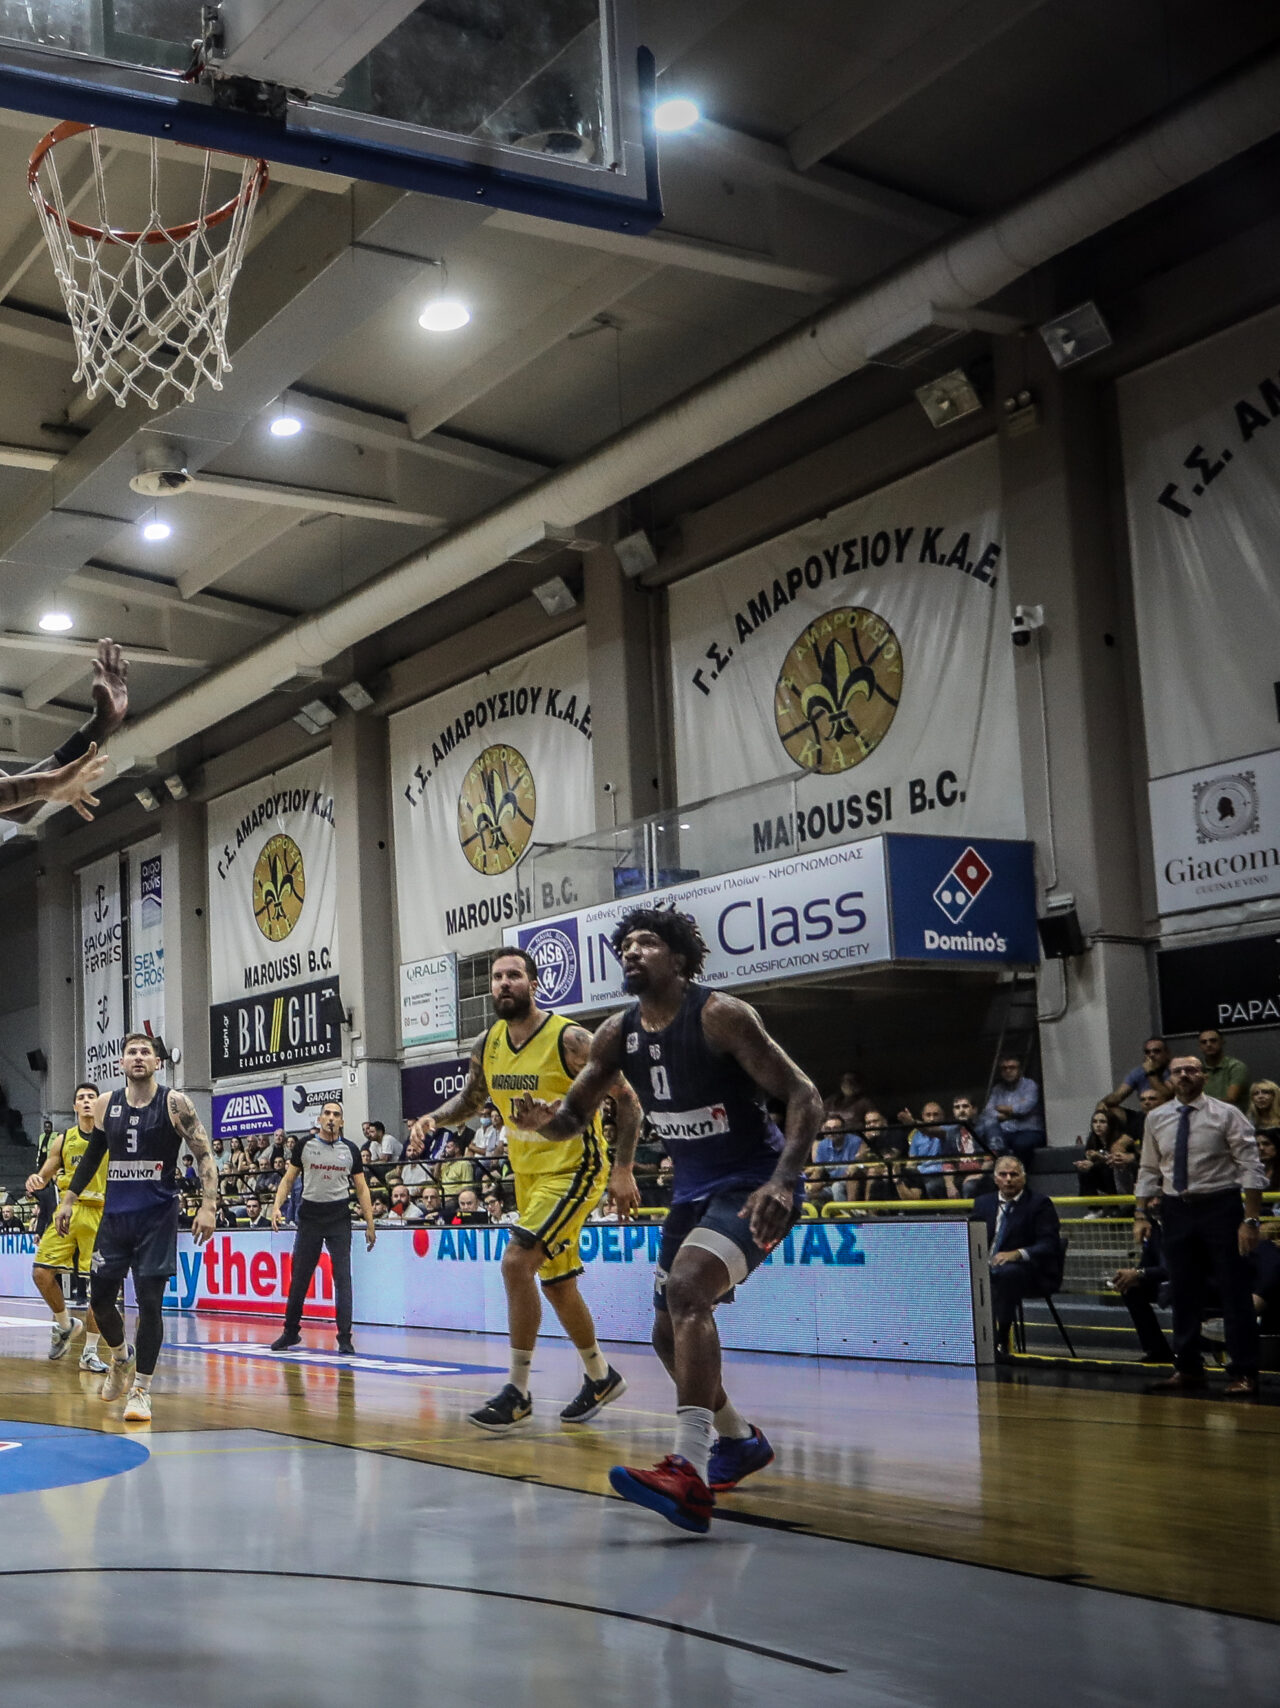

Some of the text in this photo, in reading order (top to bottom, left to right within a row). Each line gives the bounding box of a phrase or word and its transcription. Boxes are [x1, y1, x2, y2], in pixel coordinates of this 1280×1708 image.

[1158, 444, 1233, 518] Γ.Σ.
[692, 641, 734, 696] Γ.Σ.
[734, 527, 914, 645] ΑΜΑΡΟΥΣΙΟΥ
[918, 527, 1001, 589] Κ.Α.Ε.
[404, 764, 432, 808] Γ.Σ.
[431, 687, 542, 768] ΑΜΑΡΟΥΣΙΟΥ
[236, 789, 310, 848] ΑΜΑΡΟΥΣΙΟΥ
[753, 770, 966, 854] MAROUSSI B.C.
[586, 908, 616, 923] Διεθνές
[723, 873, 760, 891] Πλοίων
[768, 848, 864, 881] ΝΗΟΓΝΩΜΟΝΑΣ
[445, 876, 578, 937] MAROUSSI B.C.
[718, 891, 868, 956] Class
[924, 929, 1007, 954] Domino's
[135, 952, 155, 972] SEA
[244, 947, 332, 990] MAROUSSI B.C.
[737, 953, 819, 976] CLASSIFICATION
[823, 943, 870, 962] SOCIETY
[239, 1043, 331, 1068] ΕΙΔΙΚΟΣ ΦΩΤΙΣΜΟΣ
[307, 1089, 342, 1103] GARAGE
[492, 1075, 539, 1090] MAROUSSI
[650, 1065, 671, 1100] 0
[223, 1093, 273, 1122] ARENA
[126, 1129, 138, 1153] 3
[220, 1122, 273, 1132] CAR RENTAL
